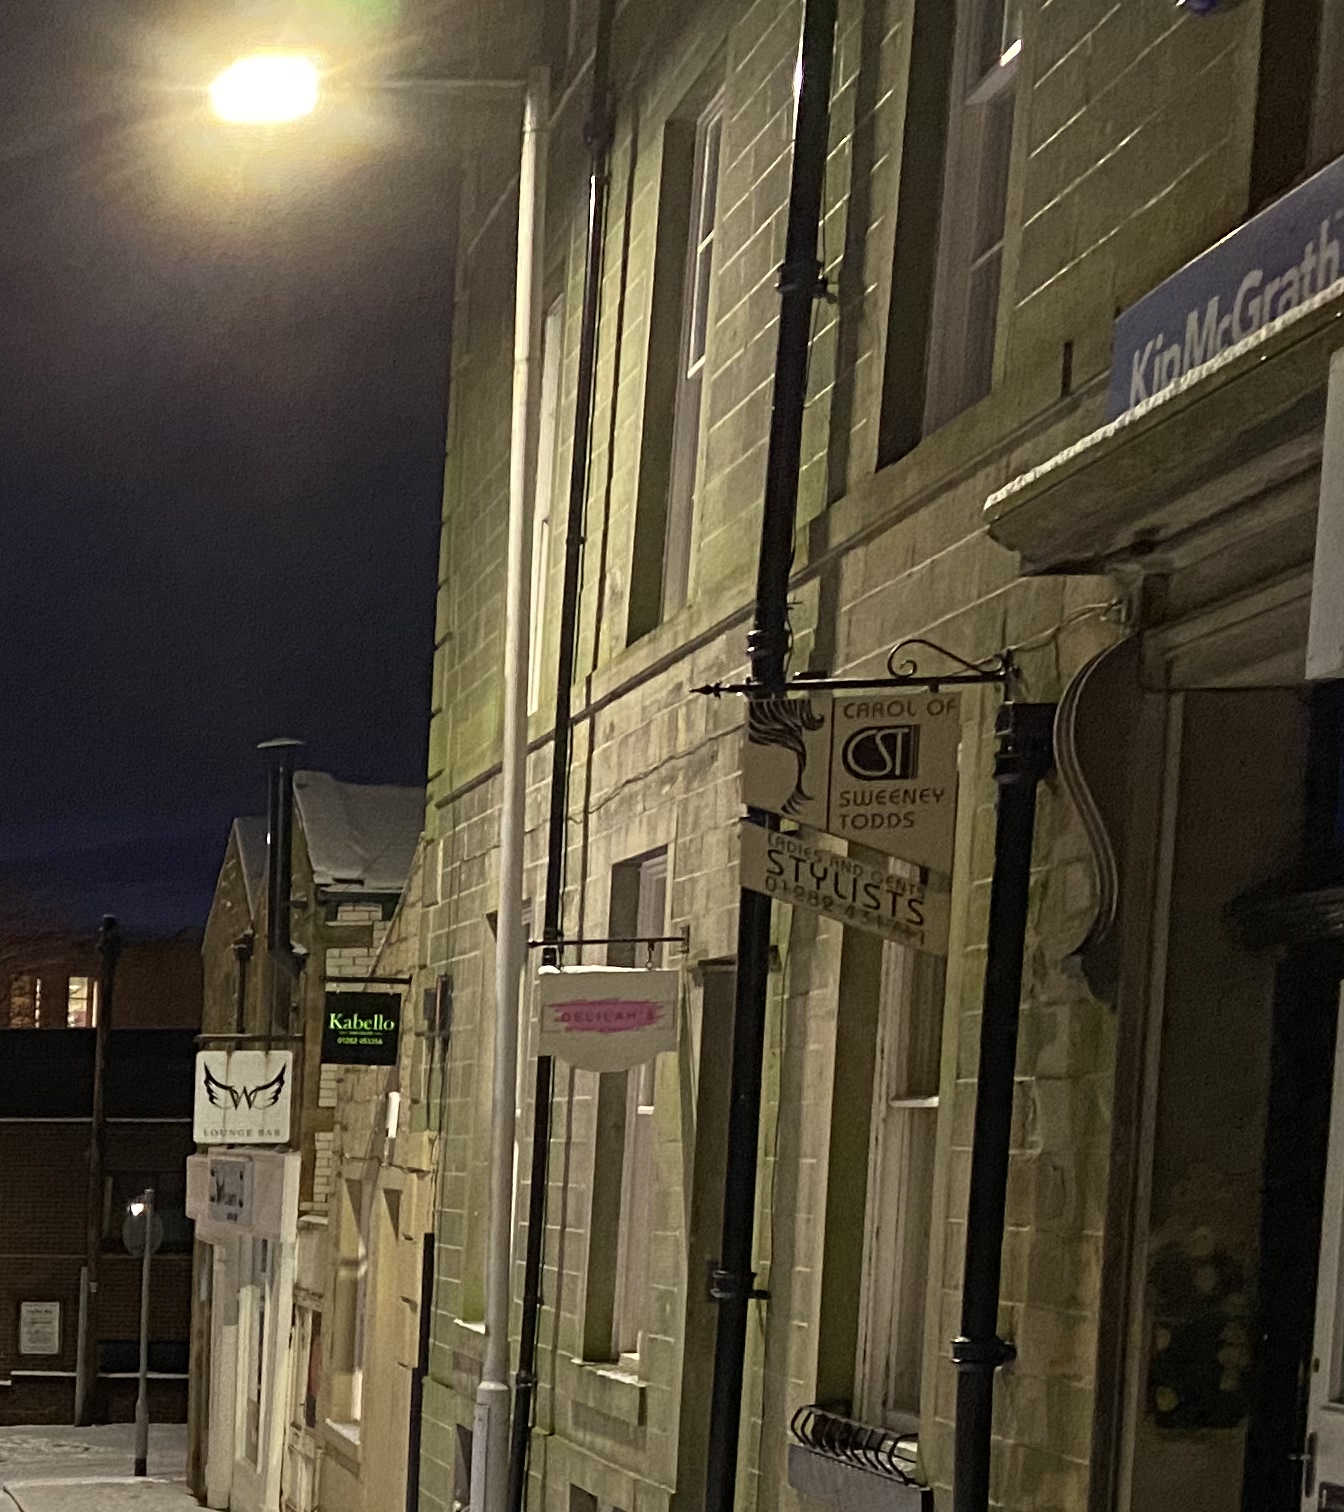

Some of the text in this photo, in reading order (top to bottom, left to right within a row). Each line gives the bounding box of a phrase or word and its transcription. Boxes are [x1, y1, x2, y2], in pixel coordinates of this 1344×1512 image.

[843, 699, 956, 720] CAROL OF
[846, 727, 912, 777] CST
[839, 786, 945, 808] SWEENEY
[839, 812, 915, 831] TODDS
[768, 832, 925, 899] LADIES AND GENTS
[765, 875, 834, 910] 01282
[766, 848, 925, 926] STYLISTS
[328, 1012, 395, 1031] Kabello
[203, 1128, 281, 1138] LOUNGE BAR
